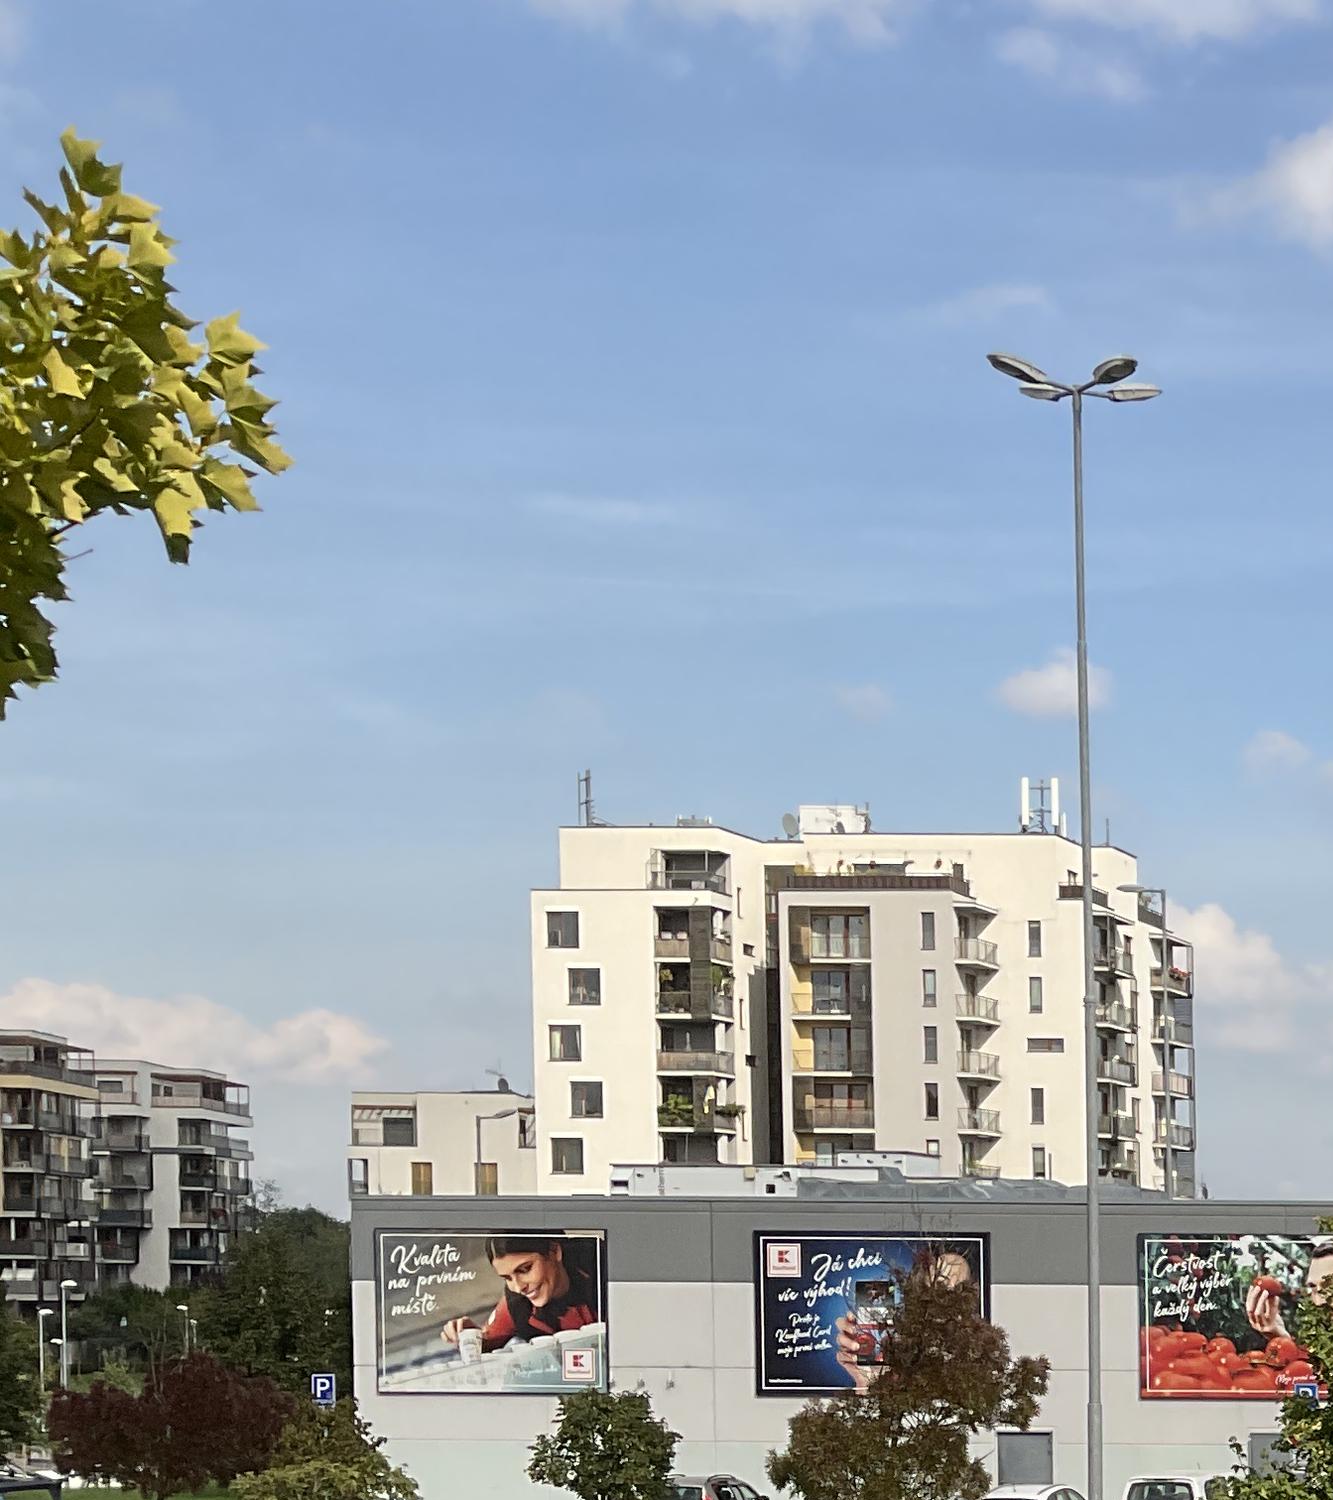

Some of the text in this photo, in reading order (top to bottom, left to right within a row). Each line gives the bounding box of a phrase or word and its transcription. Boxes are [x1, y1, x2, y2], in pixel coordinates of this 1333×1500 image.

[390, 1243, 461, 1274] Kvalita
[811, 1247, 882, 1282] Já chci
[1152, 1247, 1226, 1278] Čerstvost
[387, 1266, 477, 1297] na prvním
[778, 1276, 852, 1308] víc výhod!
[1152, 1271, 1233, 1299] a velký výběr
[1153, 1299, 1190, 1322] každý
[316, 1378, 330, 1398] P
